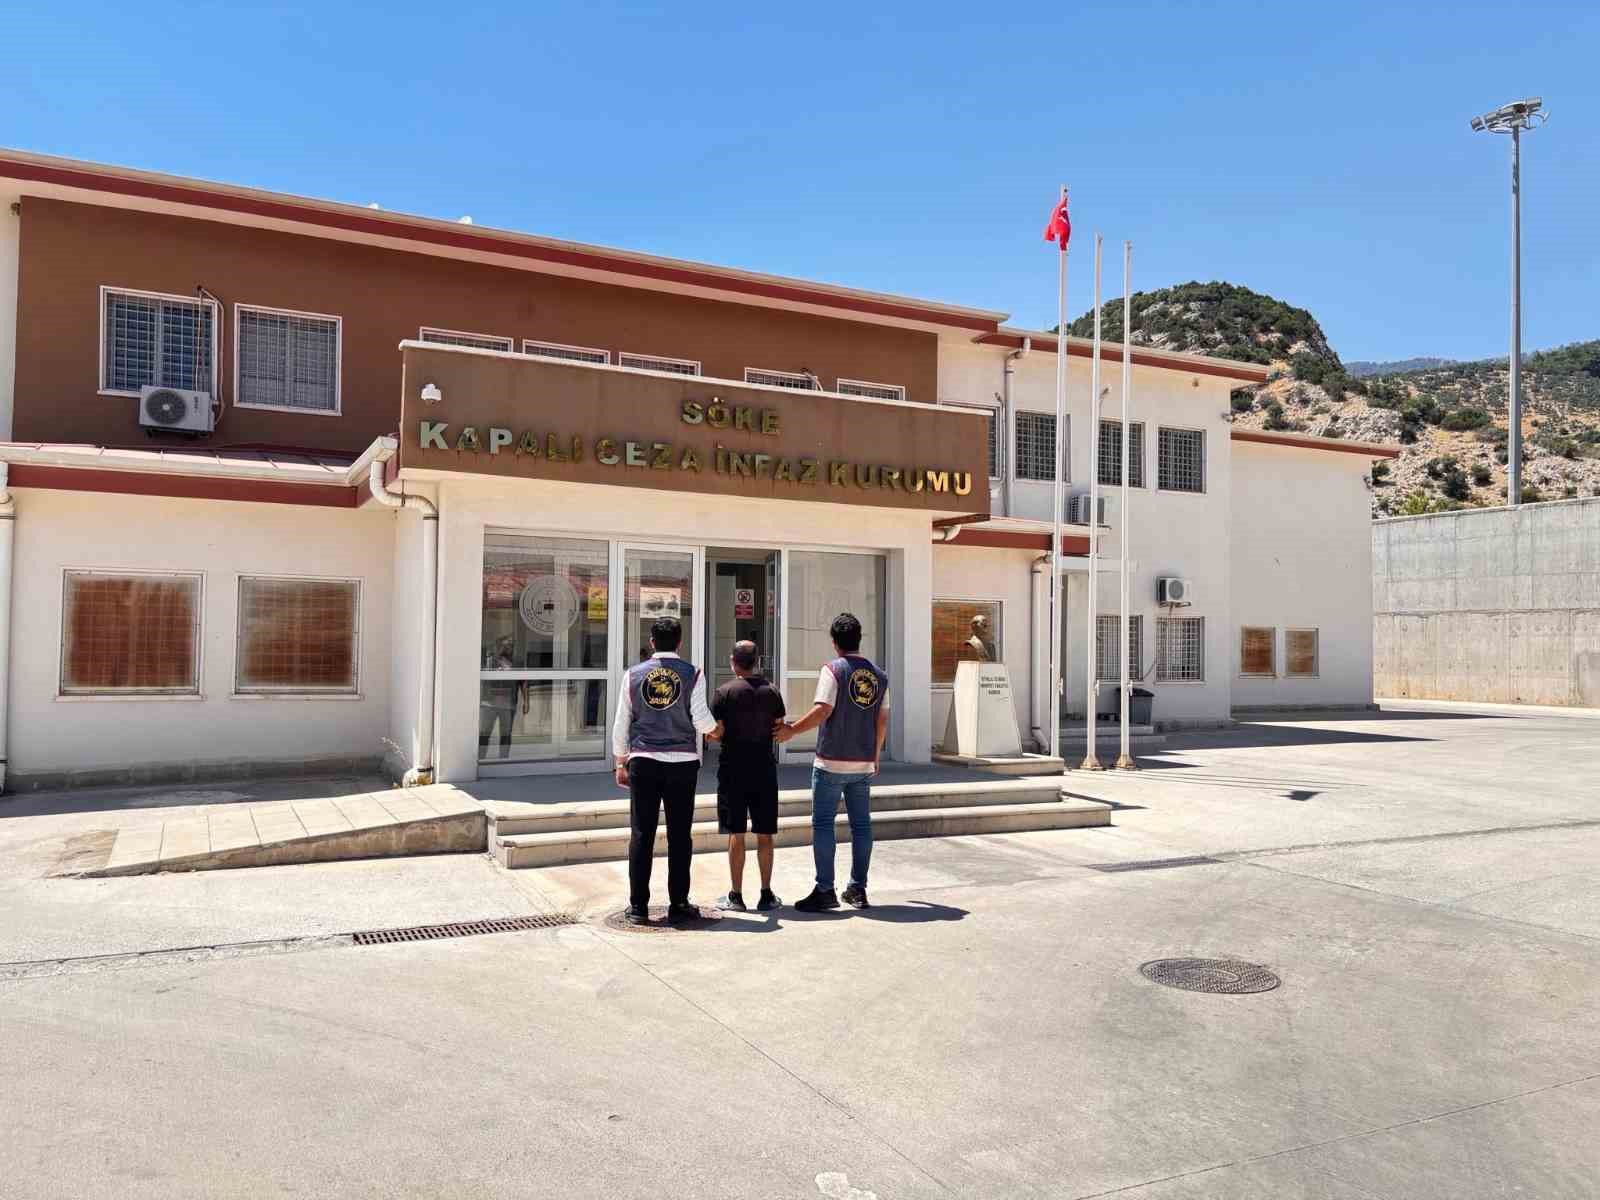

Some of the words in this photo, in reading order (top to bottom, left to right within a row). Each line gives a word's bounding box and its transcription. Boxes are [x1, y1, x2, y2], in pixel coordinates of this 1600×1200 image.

[681, 397, 779, 434] SÖKE
[419, 421, 583, 463] KAPALI
[597, 439, 700, 472] CEZA
[831, 462, 972, 496] KURUMU
